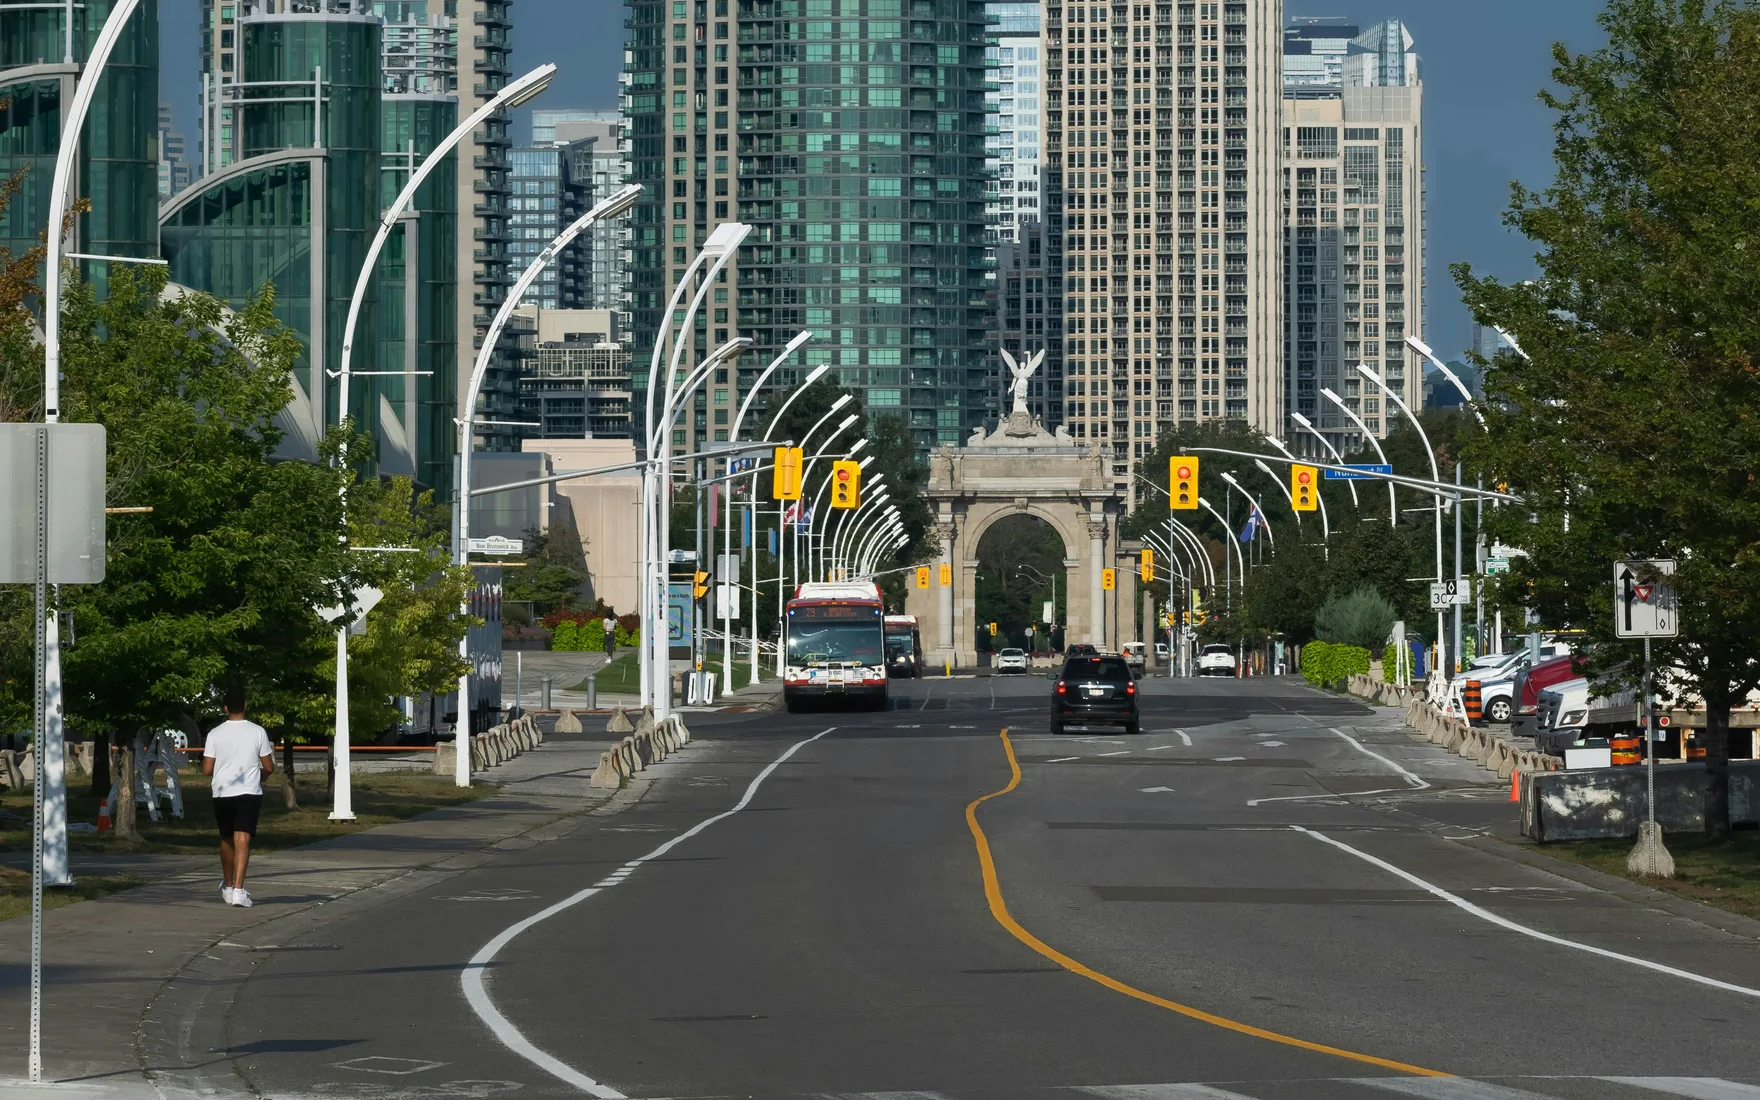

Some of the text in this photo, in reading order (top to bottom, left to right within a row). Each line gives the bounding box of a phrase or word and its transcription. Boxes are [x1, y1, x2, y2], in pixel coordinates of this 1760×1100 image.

[486, 542, 509, 550] Brunswick
[1433, 593, 1447, 605] 30
[806, 607, 816, 618] 29
